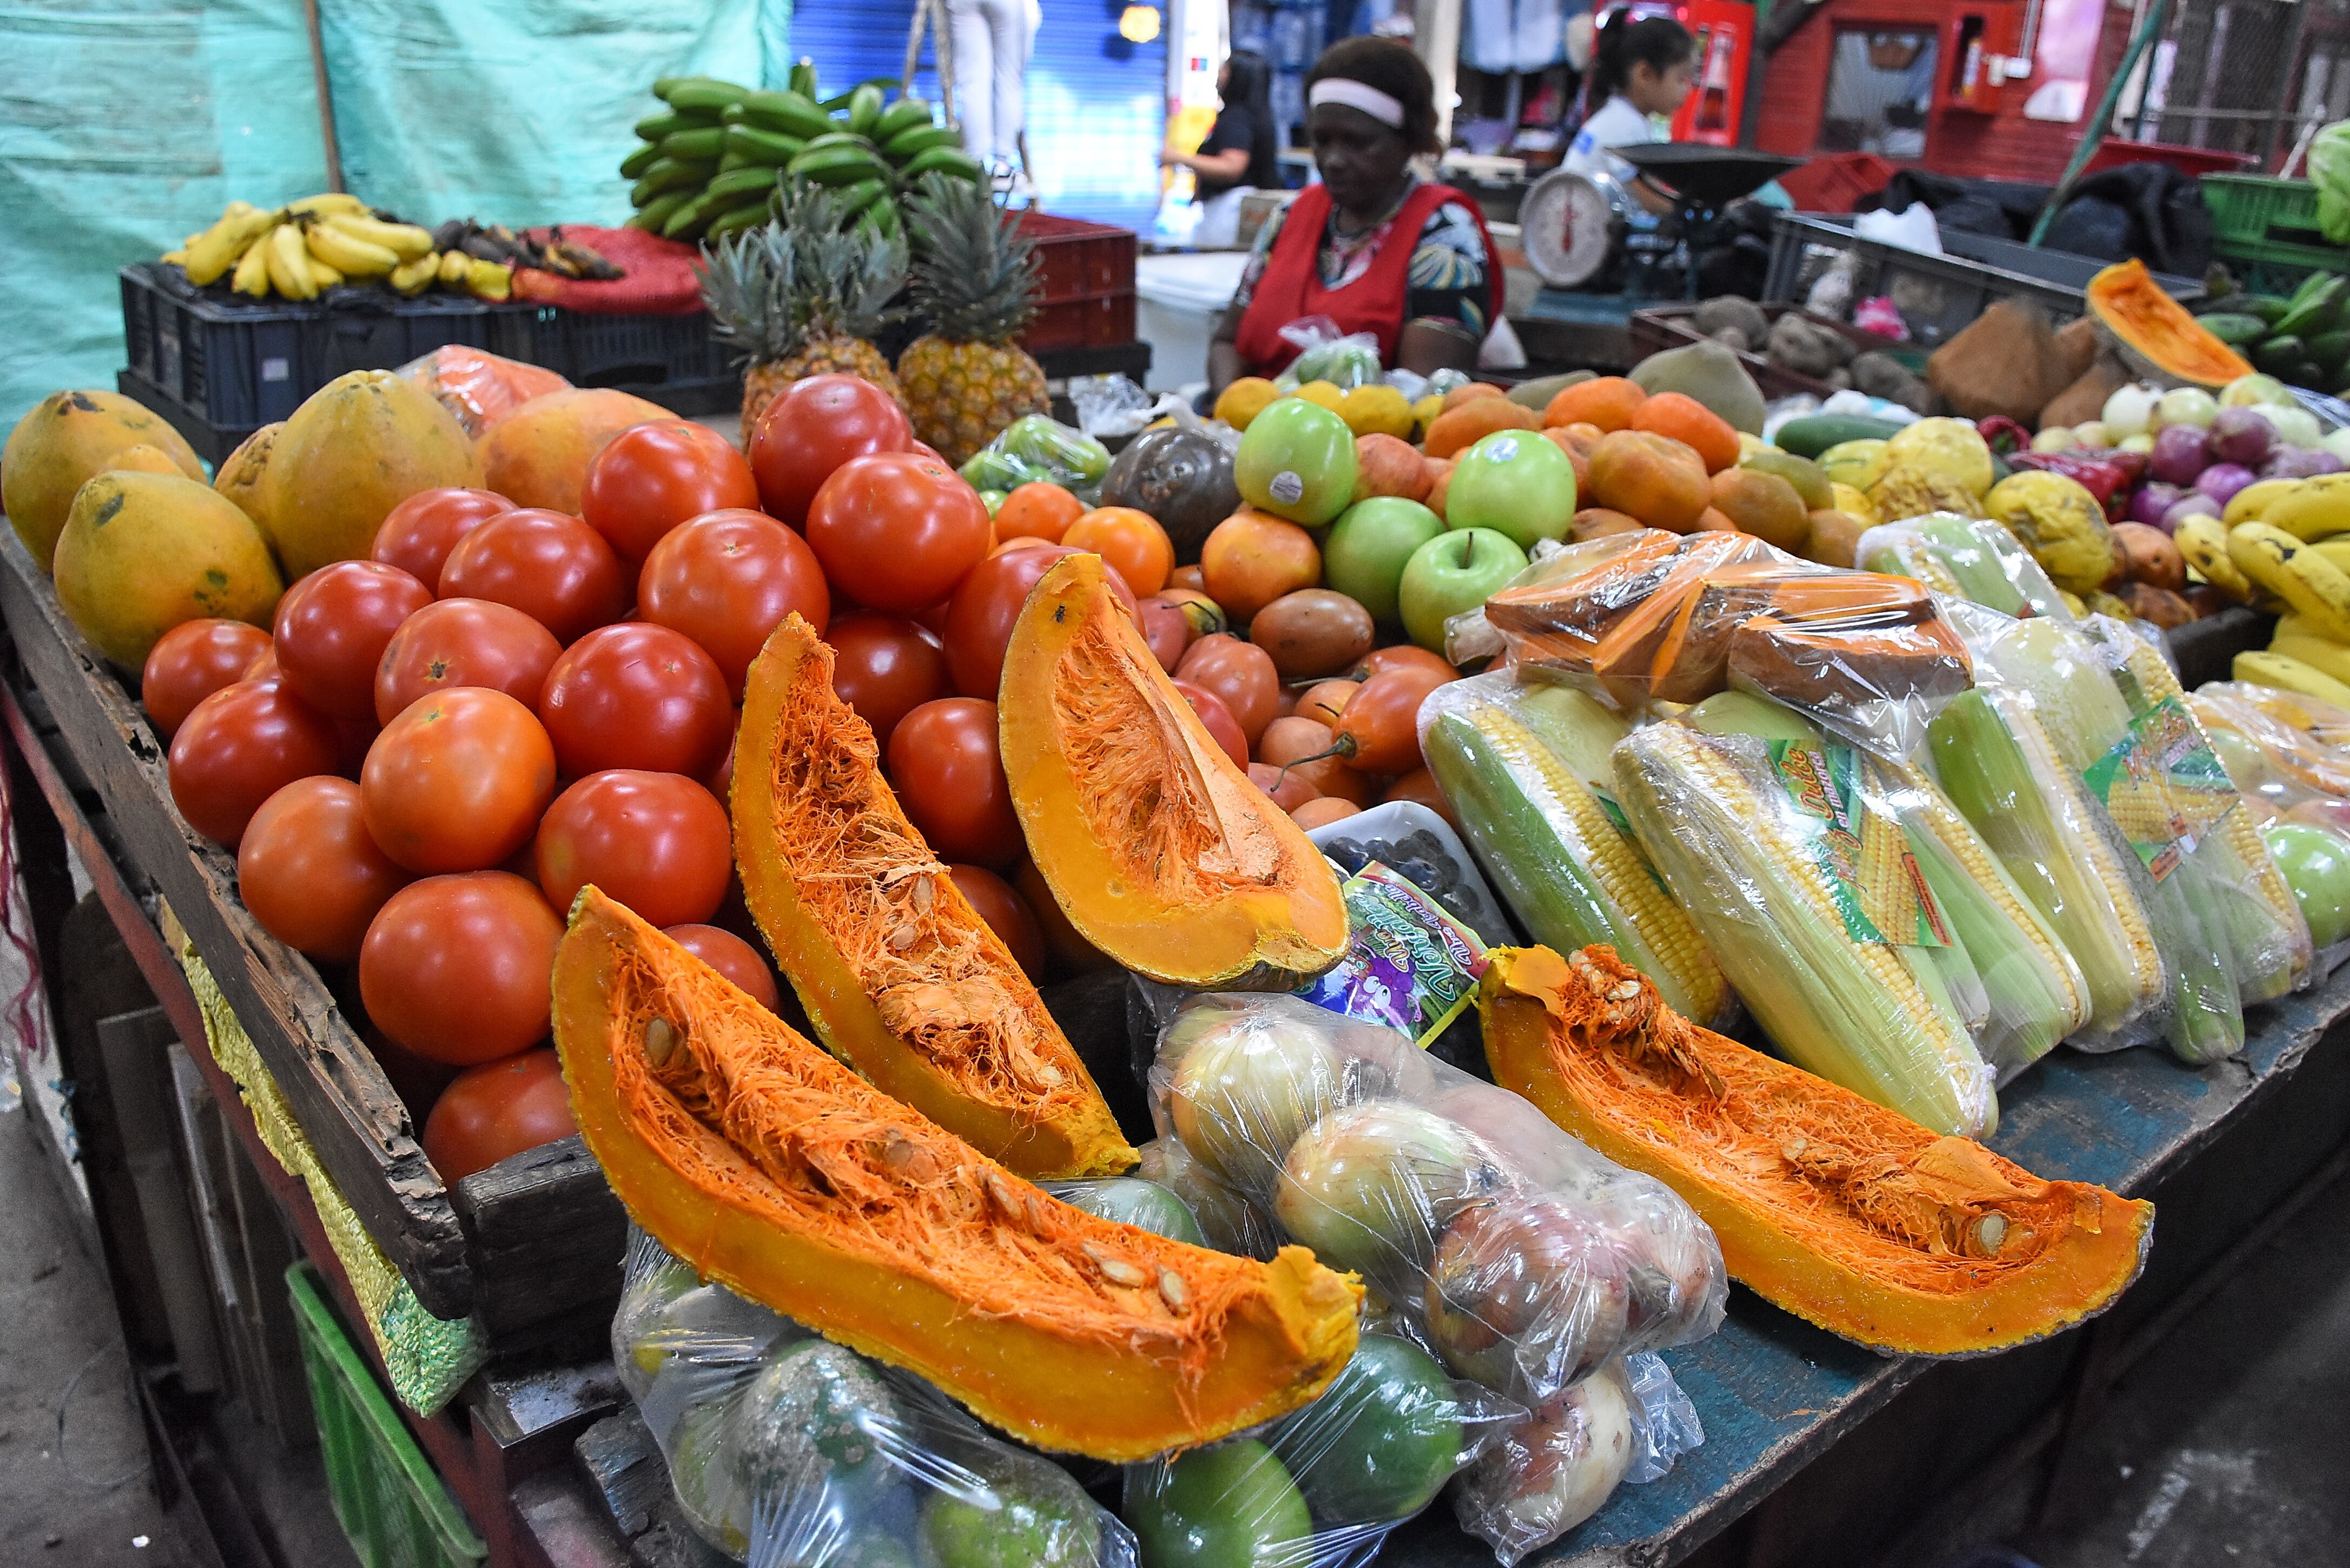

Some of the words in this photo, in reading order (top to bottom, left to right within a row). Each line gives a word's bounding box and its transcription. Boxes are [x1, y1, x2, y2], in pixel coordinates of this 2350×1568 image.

[1781, 749, 1834, 820] Dulce
[1808, 751, 1843, 809] mazorca
[1834, 811, 1850, 828] en
[1384, 883, 1442, 930] Isabella
[1375, 928, 1410, 974] Uva
[1443, 926, 1473, 966] Uva
